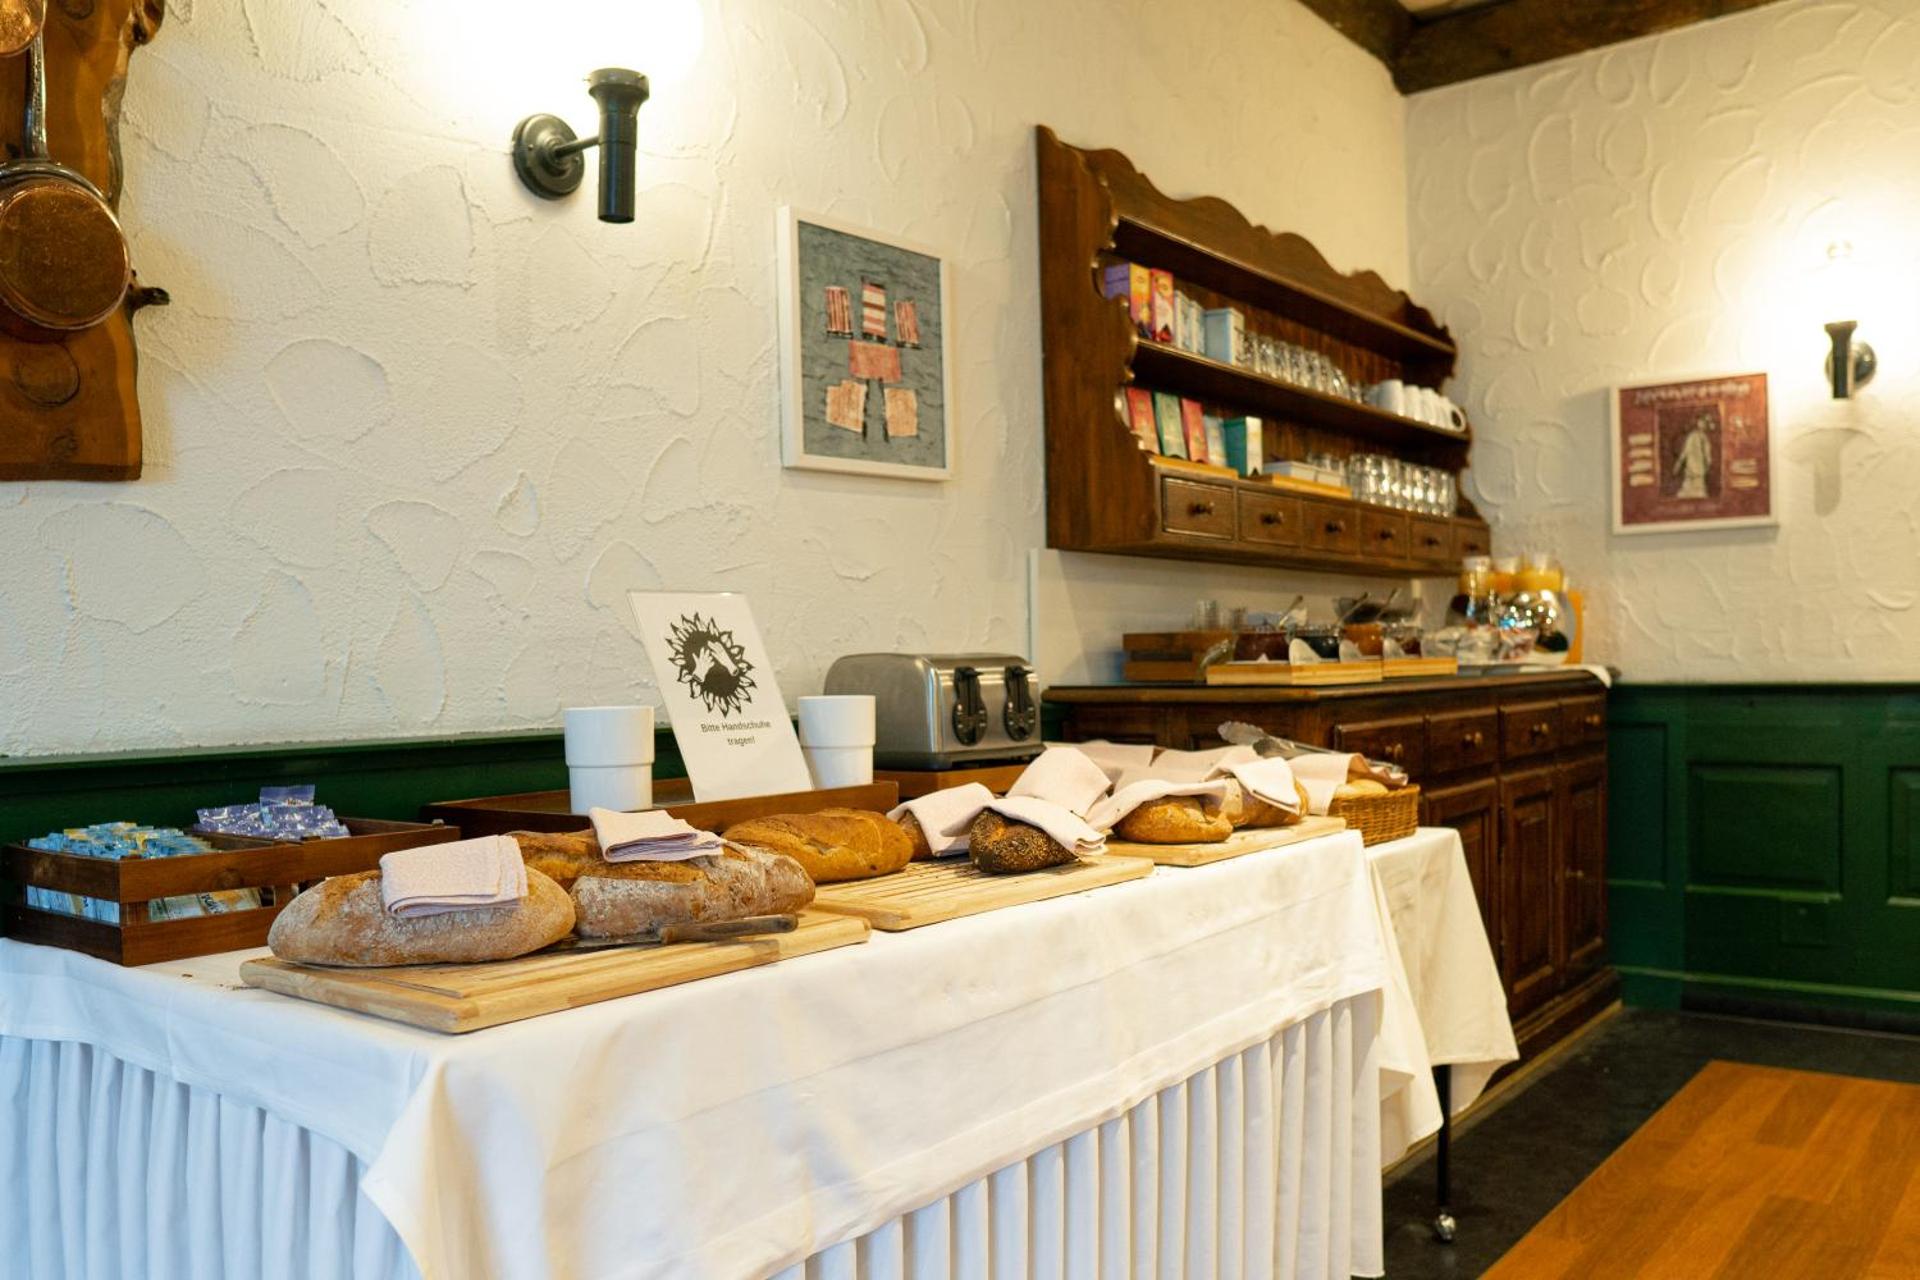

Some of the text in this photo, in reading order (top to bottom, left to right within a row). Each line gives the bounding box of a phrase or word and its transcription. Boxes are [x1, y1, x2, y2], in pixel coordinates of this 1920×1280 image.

[701, 721, 771, 732] Bitte Handschuhe
[727, 736, 755, 746] tragen!
